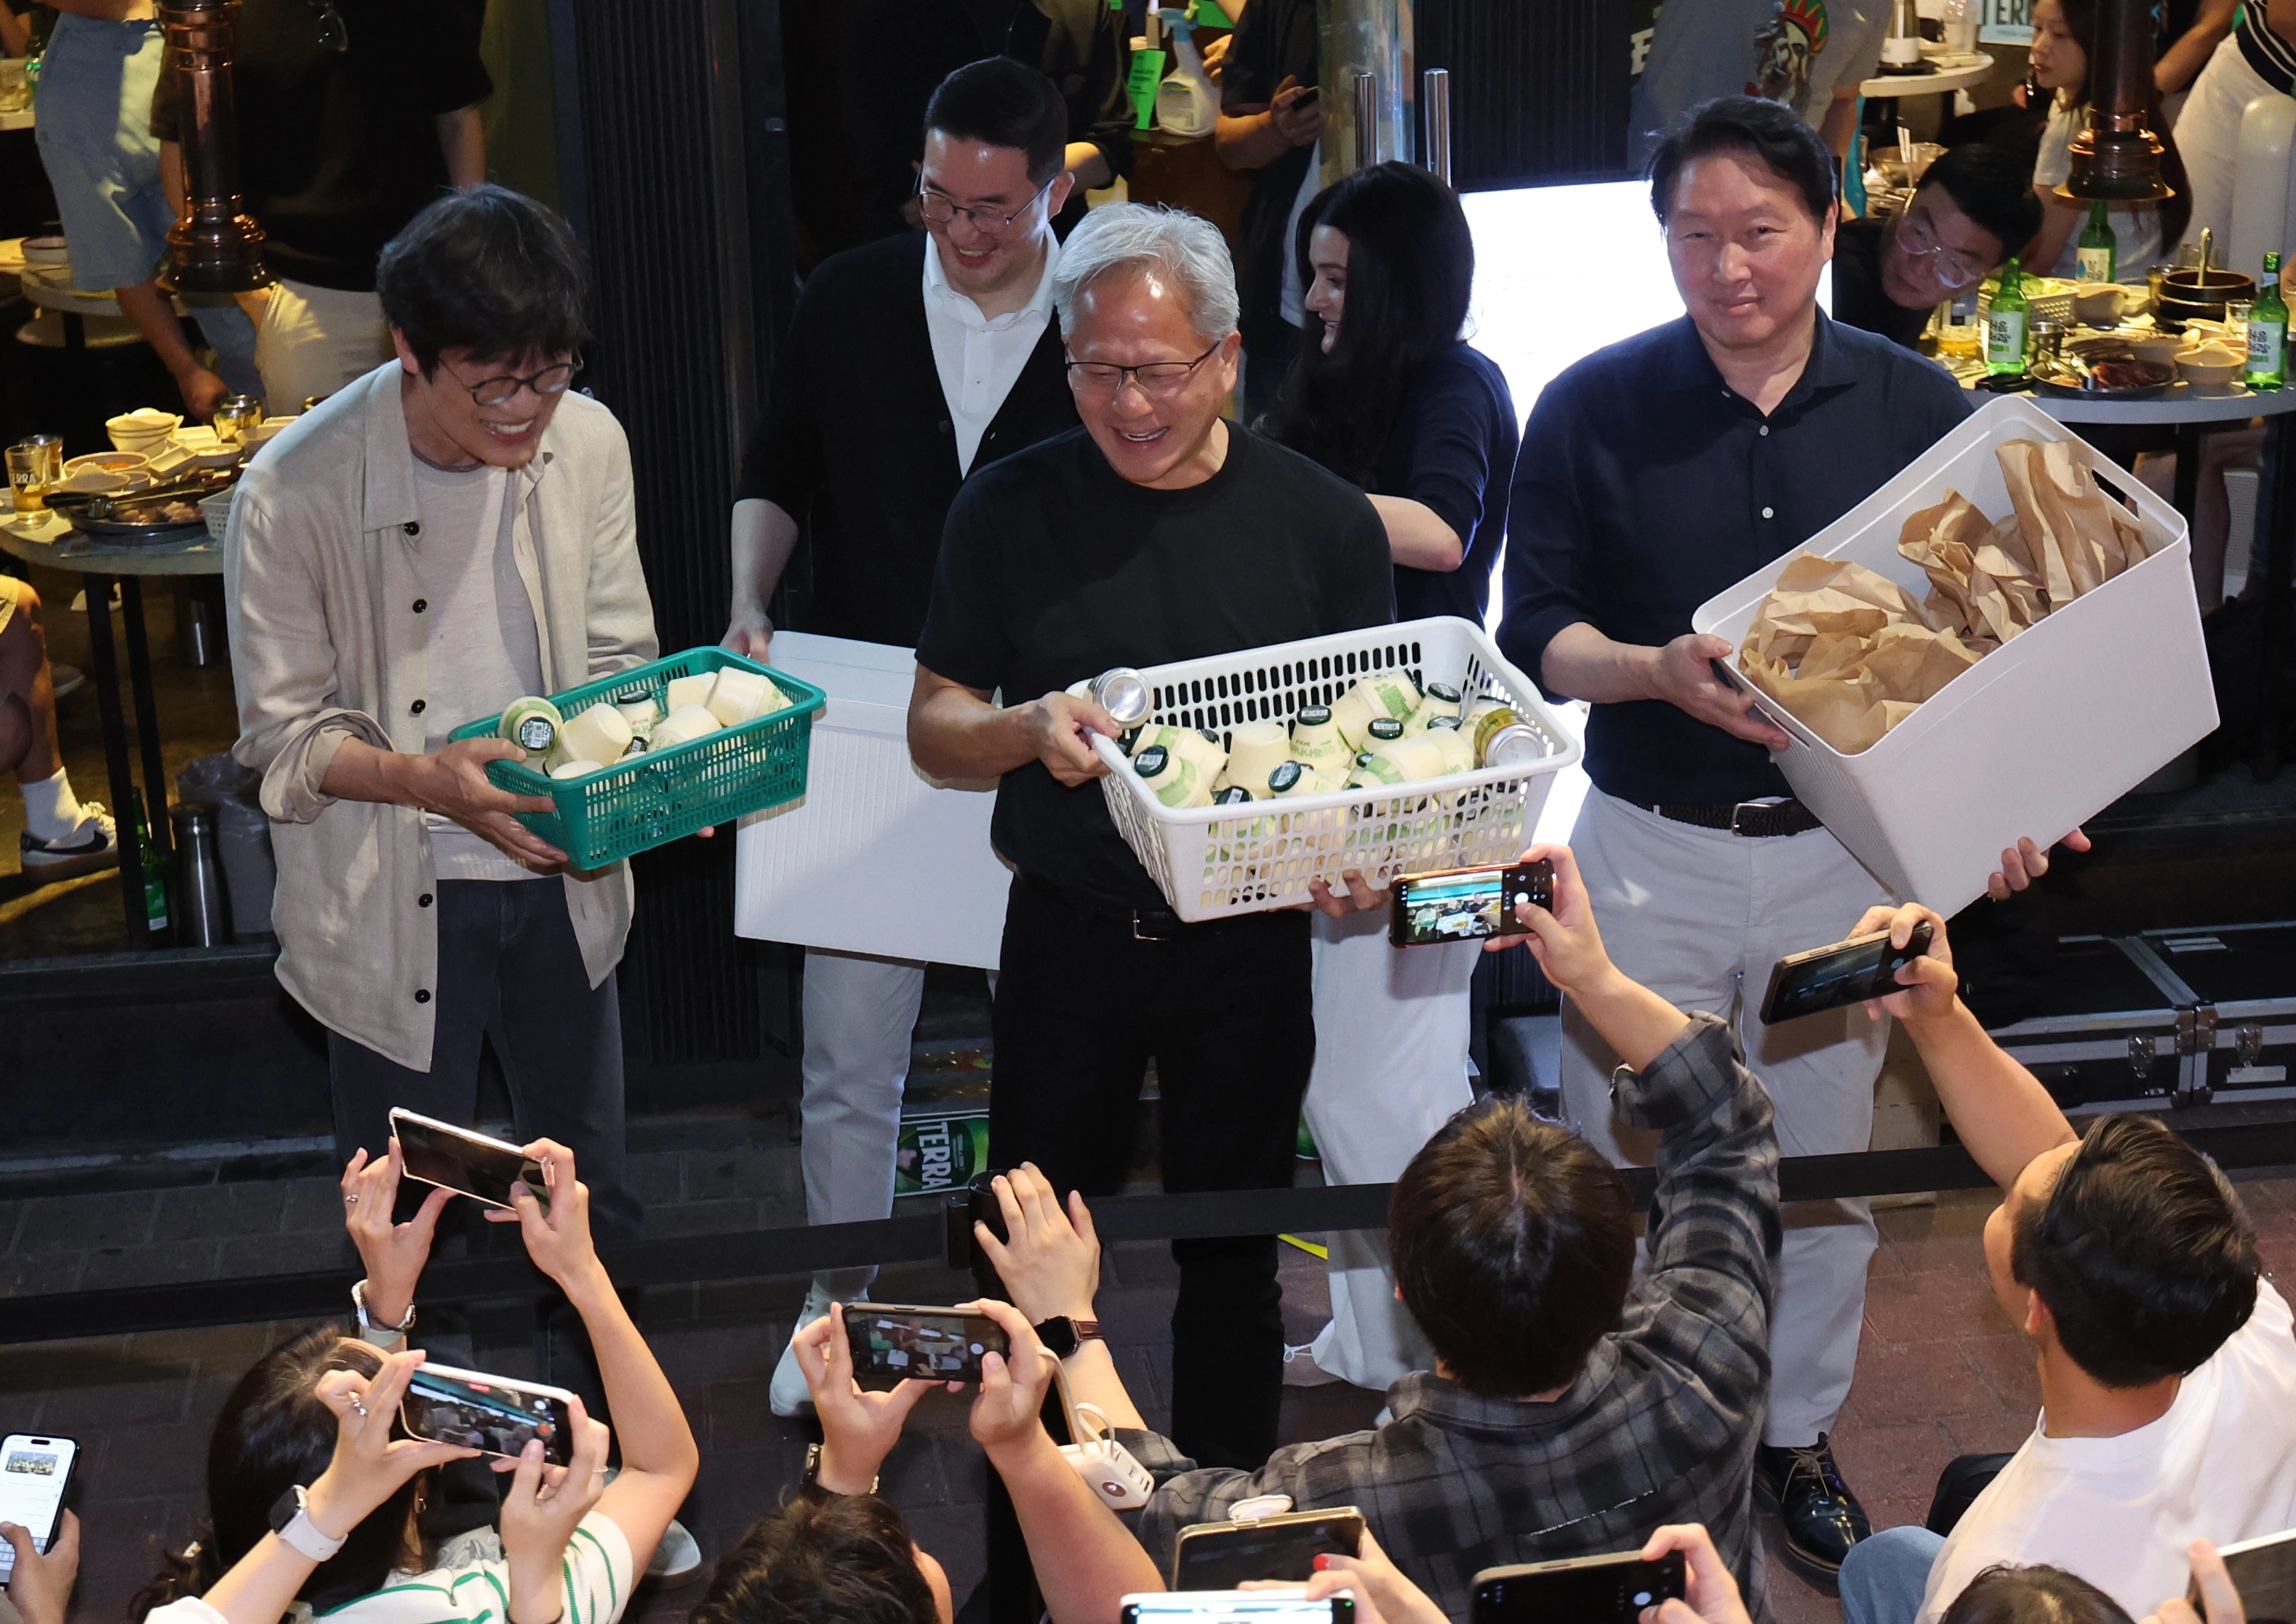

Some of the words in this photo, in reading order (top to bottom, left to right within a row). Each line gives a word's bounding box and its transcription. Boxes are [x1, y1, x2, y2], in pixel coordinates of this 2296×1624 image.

[1982, 0, 2031, 26] TER
[9, 473, 36, 484] RRA
[916, 1121, 952, 1190] TERRA
